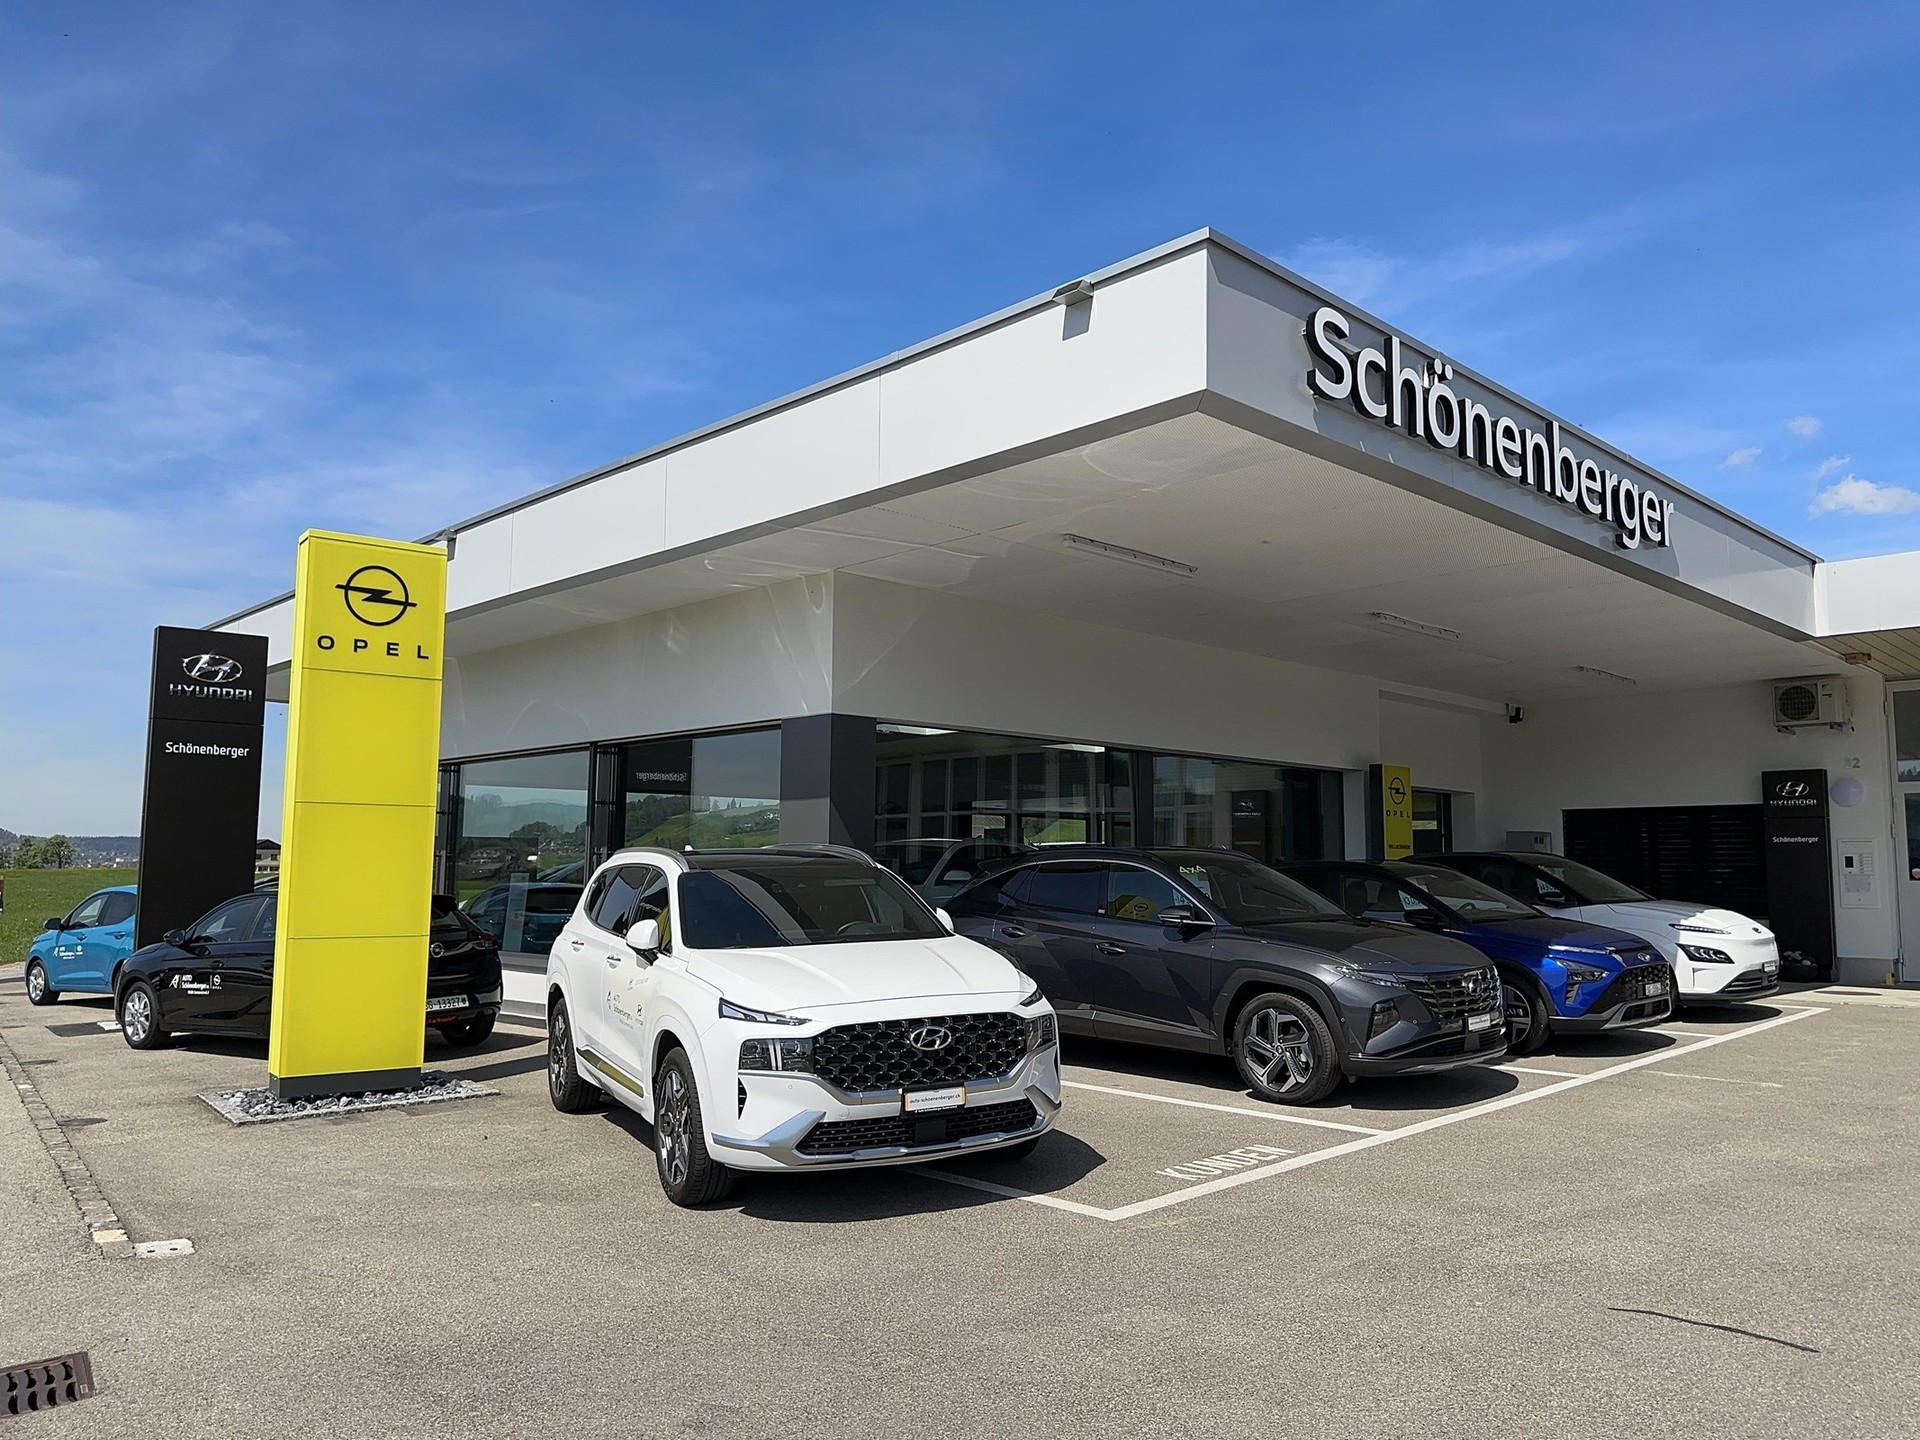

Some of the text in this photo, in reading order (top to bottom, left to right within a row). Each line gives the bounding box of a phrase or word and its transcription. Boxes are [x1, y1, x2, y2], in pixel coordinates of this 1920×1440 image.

[1307, 306, 1674, 550] Schönenberger
[317, 635, 430, 660] OPEL
[169, 683, 253, 701] HYUNDAI
[165, 742, 250, 758] Schönenberger
[1769, 798, 1817, 806] HYUNDAI
[1386, 809, 1411, 818] OPEL
[1773, 836, 1819, 844] Schönenberger
[1155, 1144, 1296, 1181] KUNDEN
